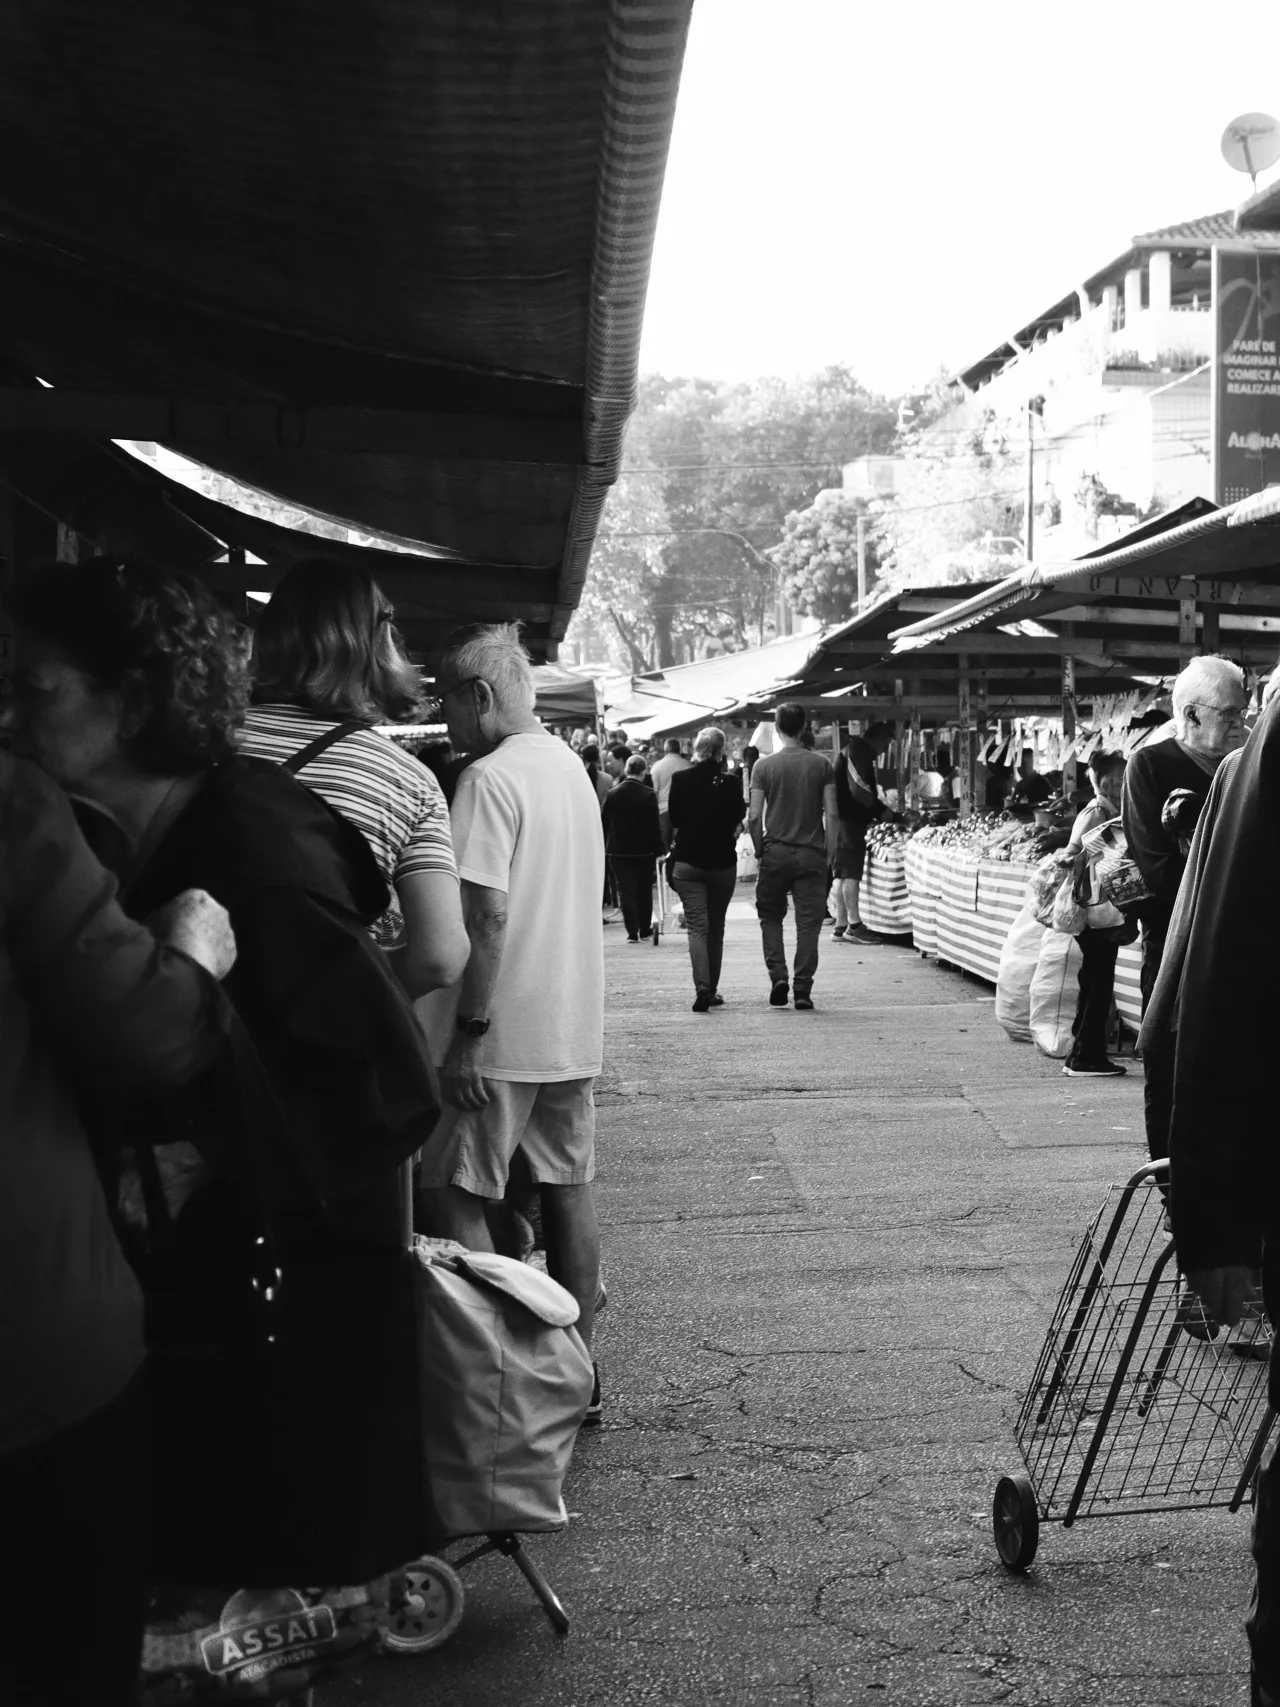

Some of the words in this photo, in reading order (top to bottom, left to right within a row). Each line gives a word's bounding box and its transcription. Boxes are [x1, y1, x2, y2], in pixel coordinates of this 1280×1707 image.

[1262, 341, 1276, 352] DE
[1223, 355, 1277, 366] IMAGINAR
[1227, 368, 1271, 380] COMECE
[1227, 382, 1280, 396] REALIZAR!
